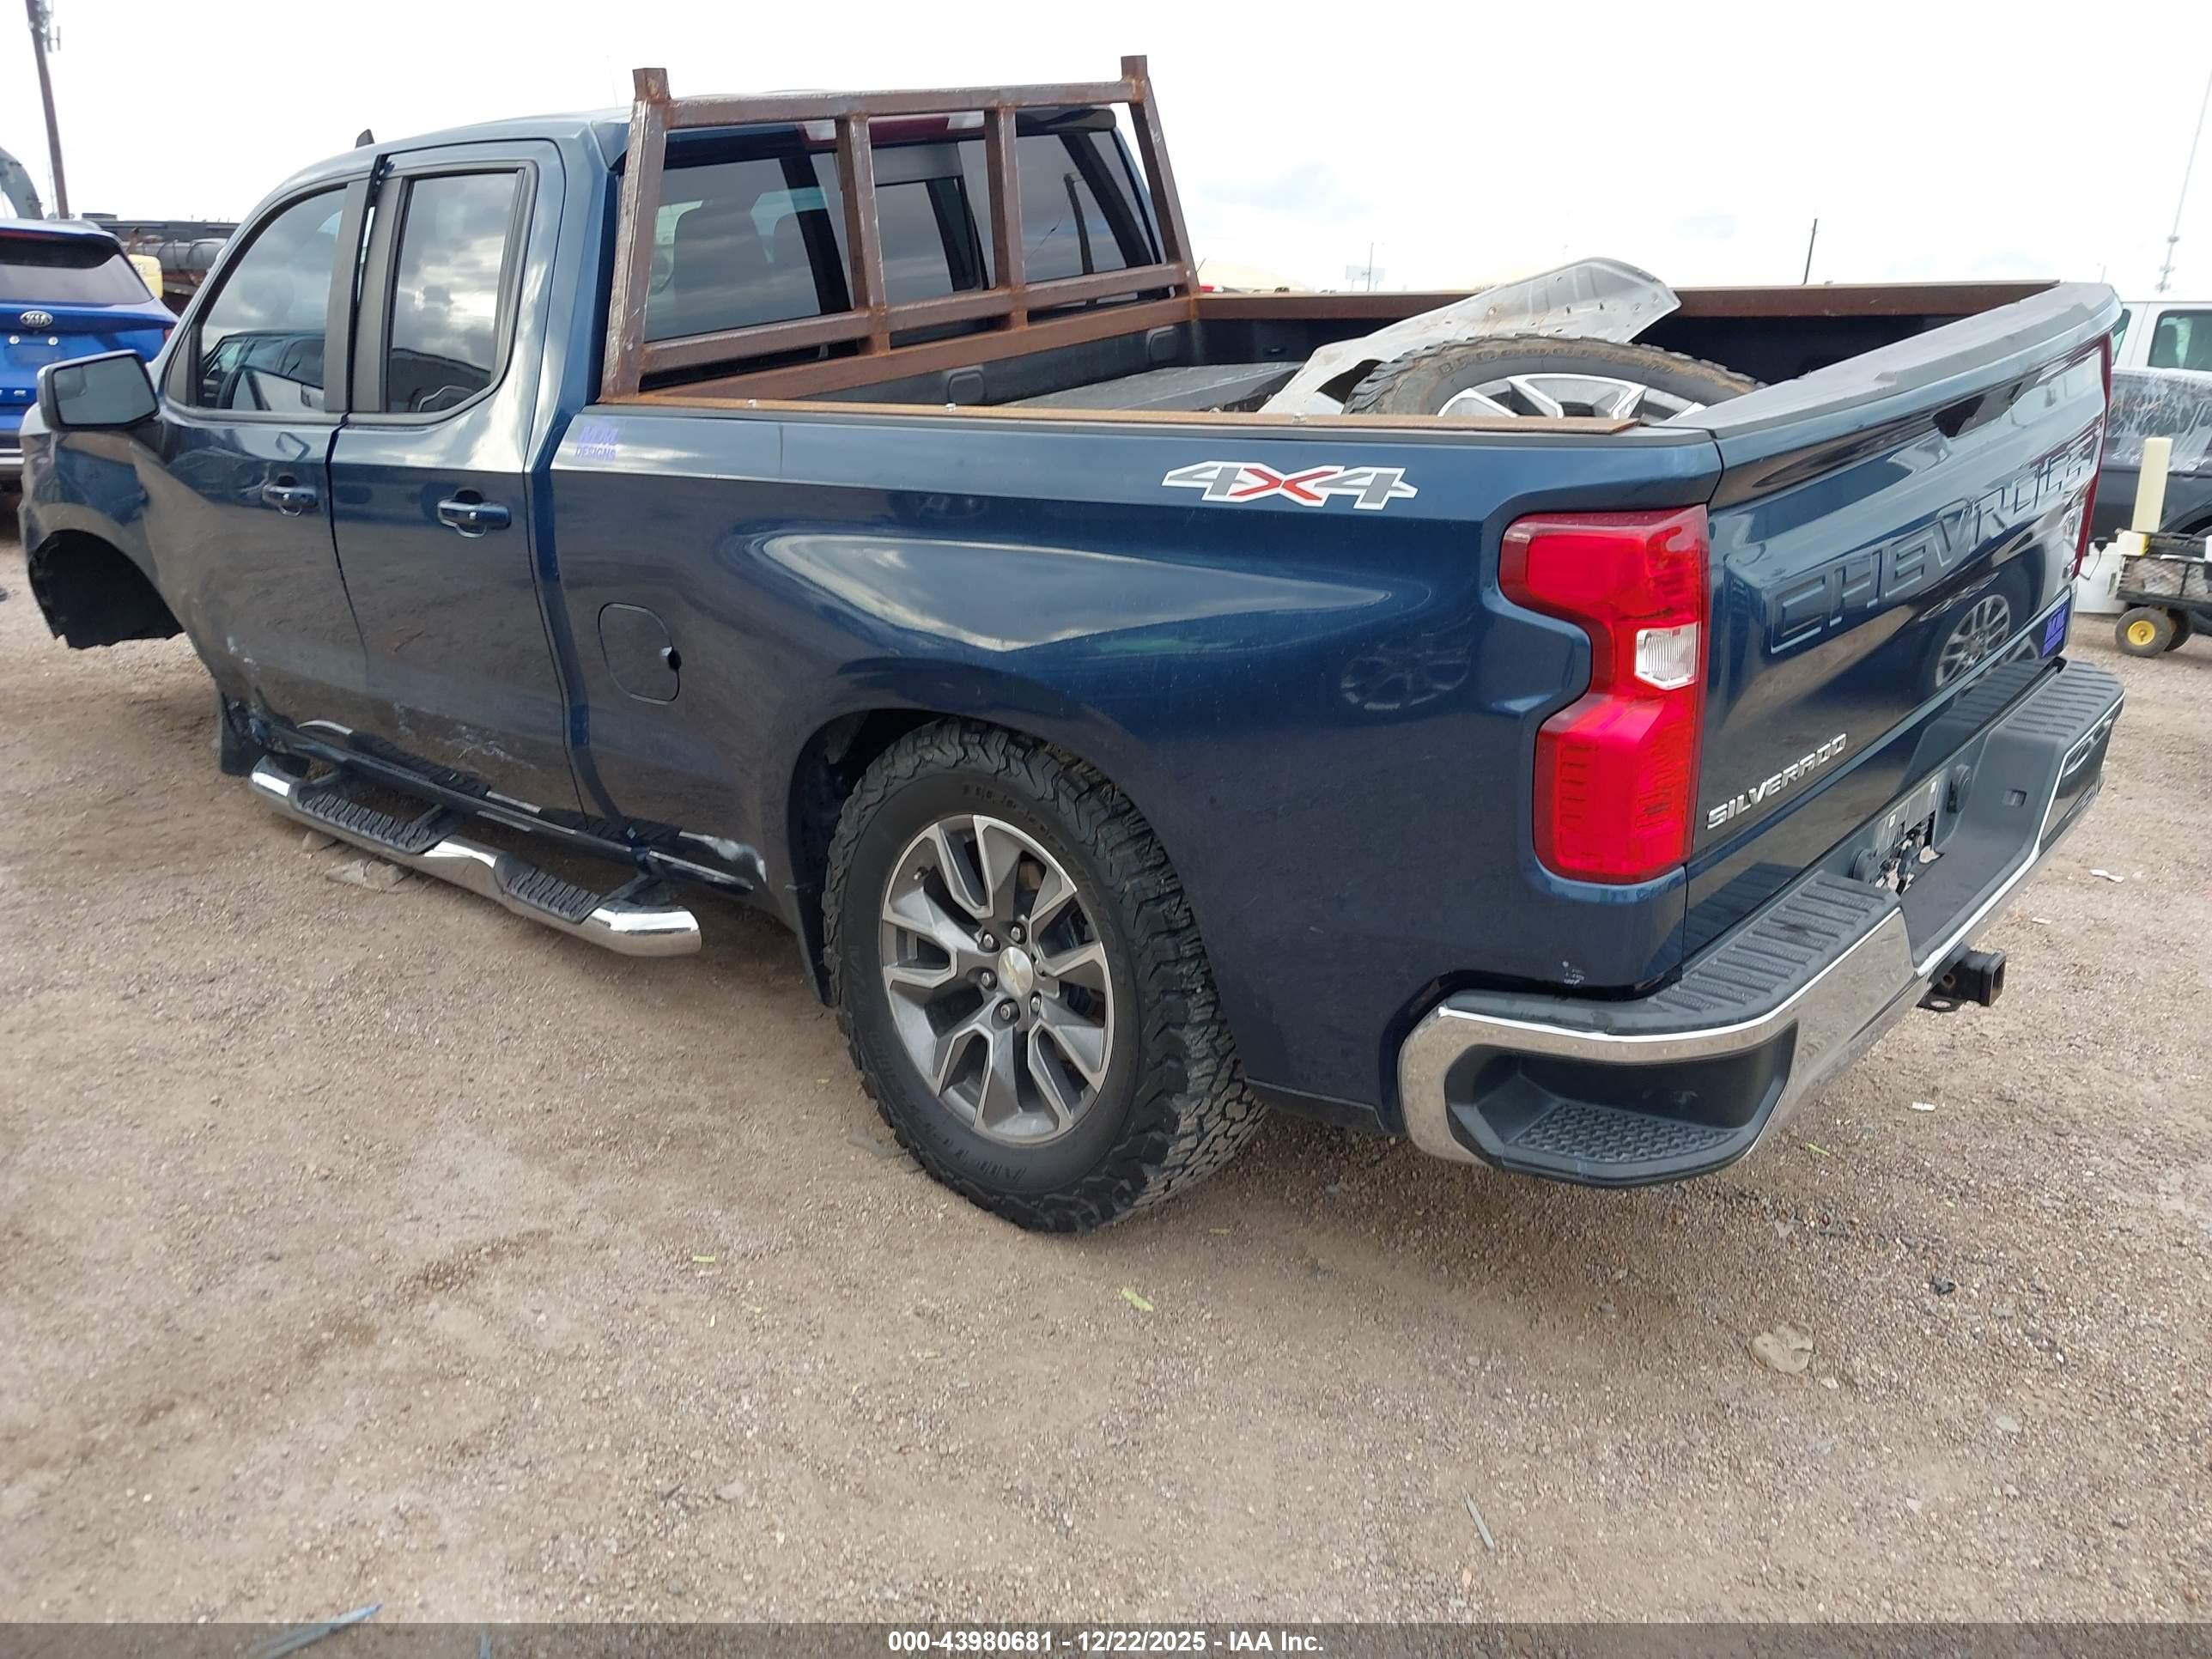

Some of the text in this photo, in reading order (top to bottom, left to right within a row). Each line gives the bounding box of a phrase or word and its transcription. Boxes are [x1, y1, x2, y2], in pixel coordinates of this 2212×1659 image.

[575, 446, 617, 461] DESIGNS
[1771, 431, 2099, 654] CHEVROLET
[1706, 732, 1847, 830] SILVERADO
